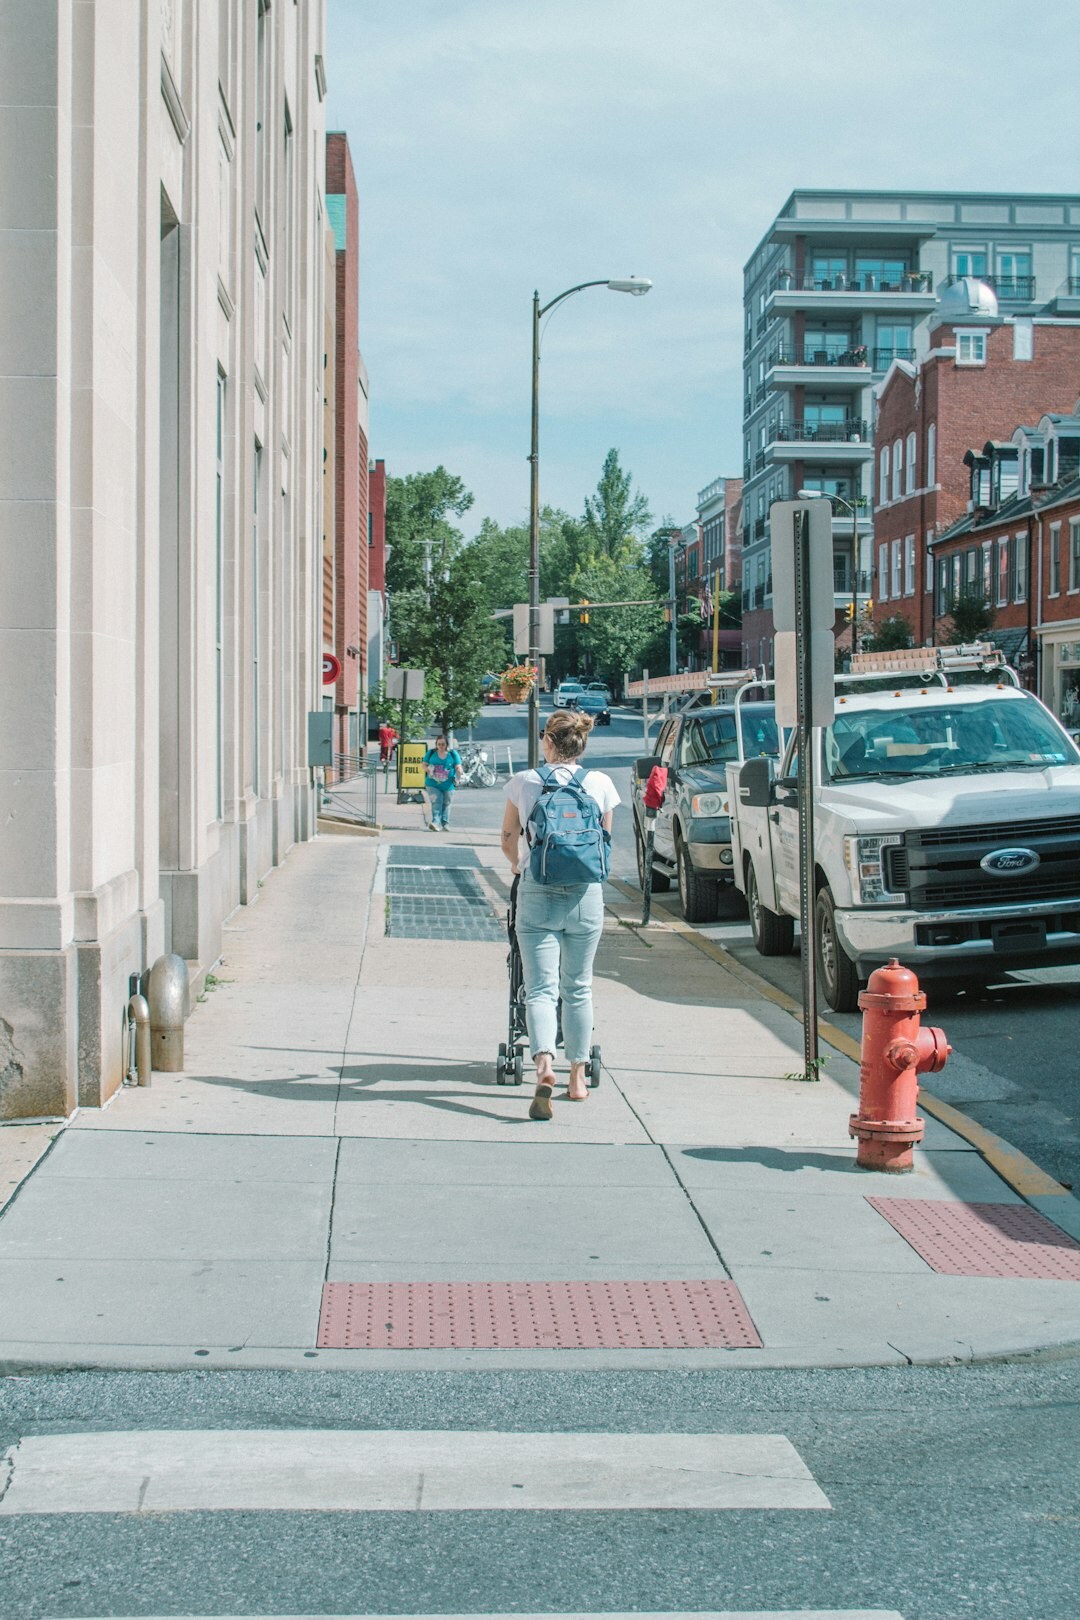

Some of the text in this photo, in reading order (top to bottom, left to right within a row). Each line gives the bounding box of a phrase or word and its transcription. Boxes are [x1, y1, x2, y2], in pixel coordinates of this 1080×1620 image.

[401, 756, 424, 764] ARAG
[404, 766, 419, 774] FULL
[997, 855, 1025, 869] Ford
